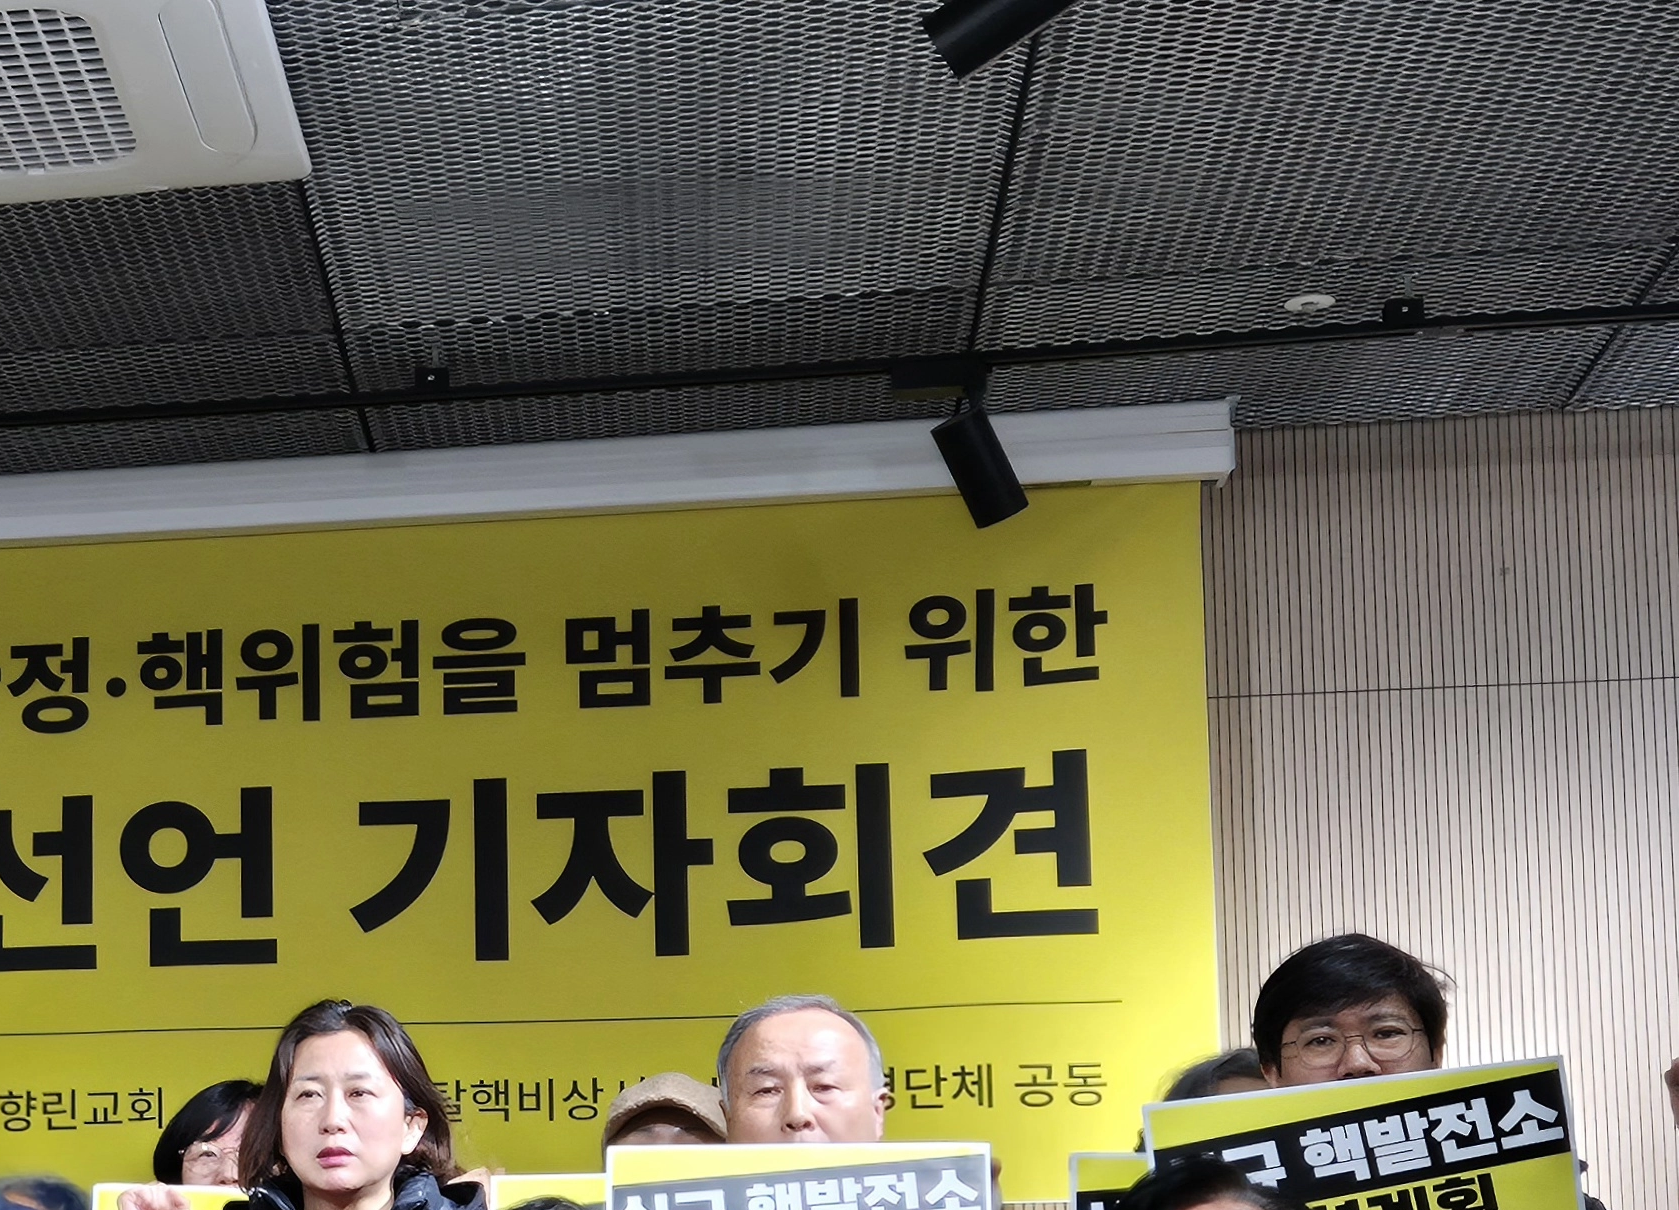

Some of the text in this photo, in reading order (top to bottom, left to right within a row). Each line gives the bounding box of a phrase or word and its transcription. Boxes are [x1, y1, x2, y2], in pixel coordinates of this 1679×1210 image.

[564, 597, 860, 709] 멈추기
[904, 583, 1109, 692] 위한
[348, 748, 1099, 962] 기자회견
[1014, 1063, 1108, 1108] 공동
[1299, 1088, 1565, 1184] 핵발전소
